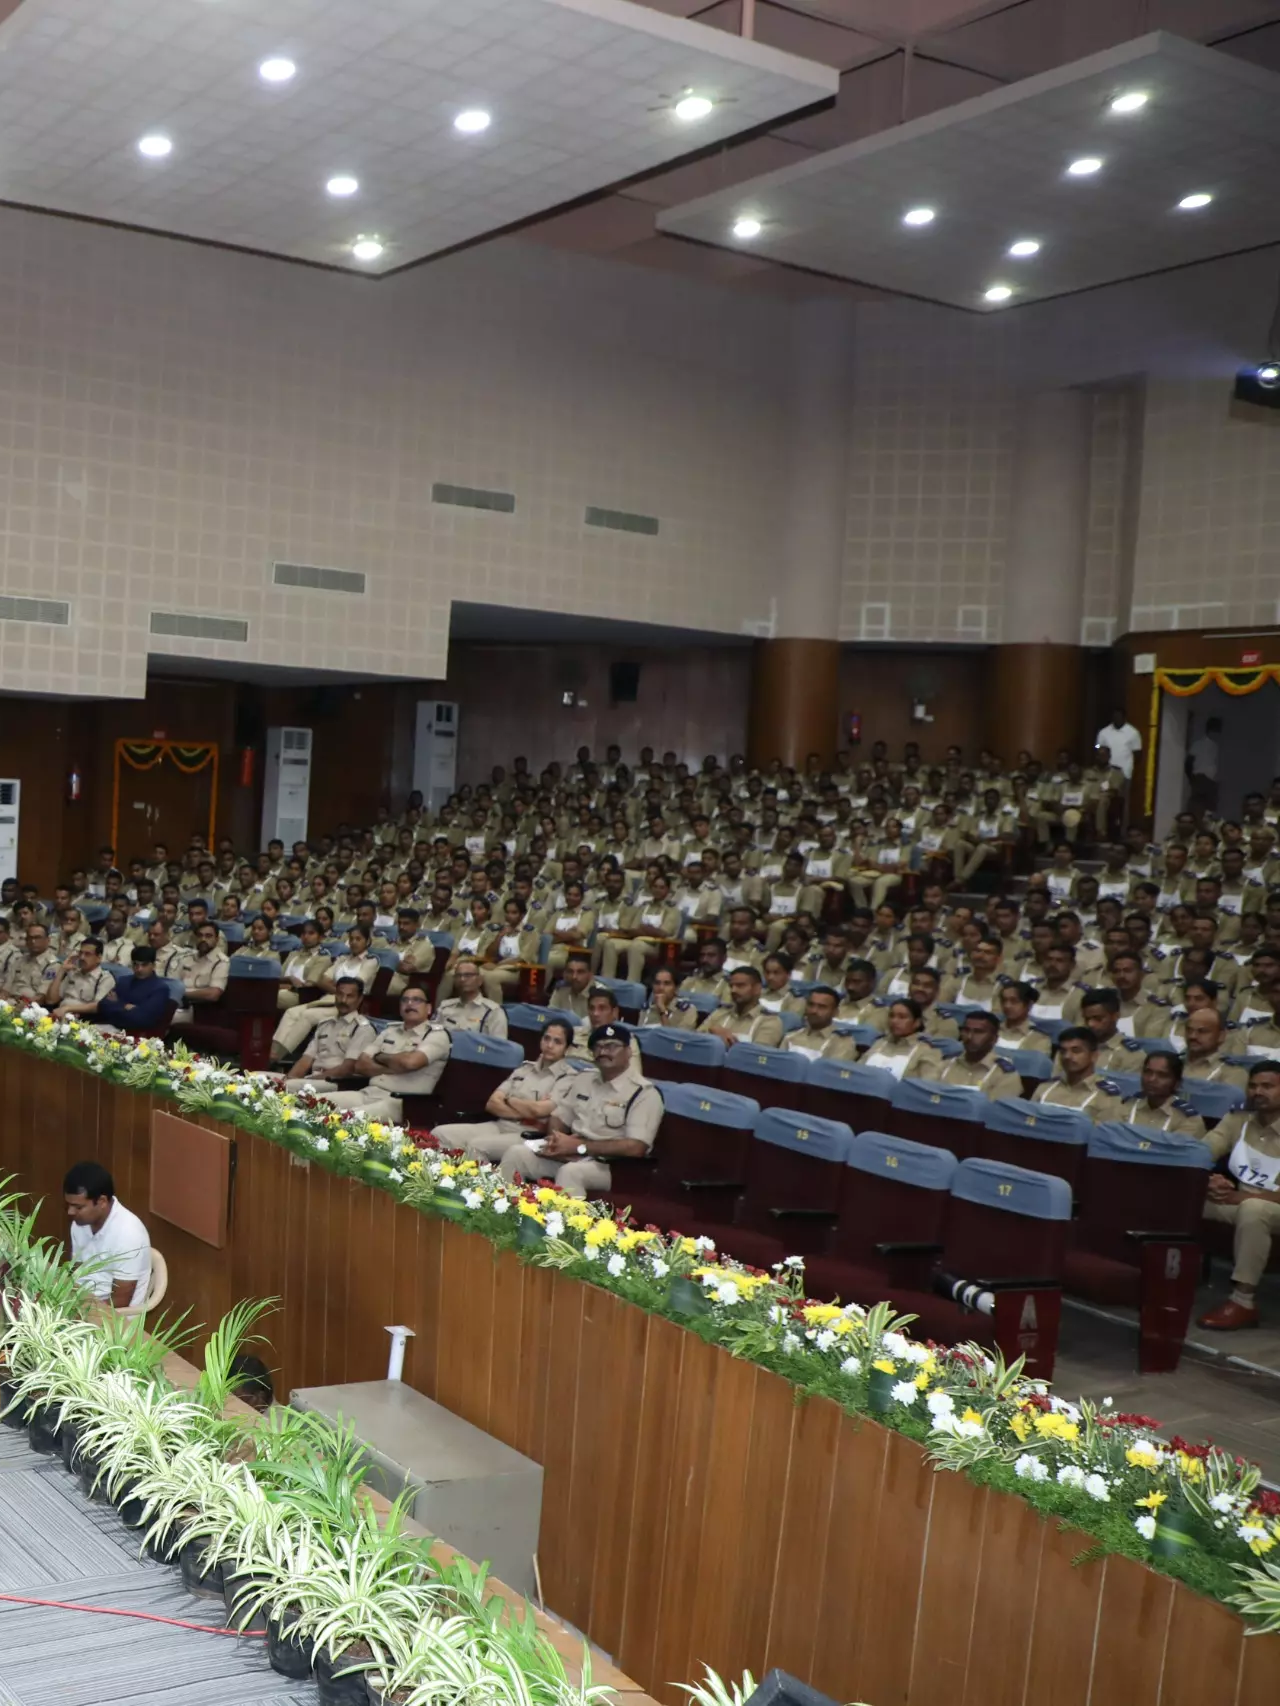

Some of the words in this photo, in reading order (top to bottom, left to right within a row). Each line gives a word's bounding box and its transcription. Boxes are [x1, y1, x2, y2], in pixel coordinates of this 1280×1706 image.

[700, 1101, 711, 1112] 14
[796, 1129, 809, 1140] 15
[1138, 1140, 1151, 1151] 17
[885, 1156, 898, 1168] 16
[1238, 1165, 1269, 1188] 172
[998, 1184, 1013, 1197] 17
[1164, 1247, 1181, 1280] B
[1019, 1294, 1038, 1330] A
